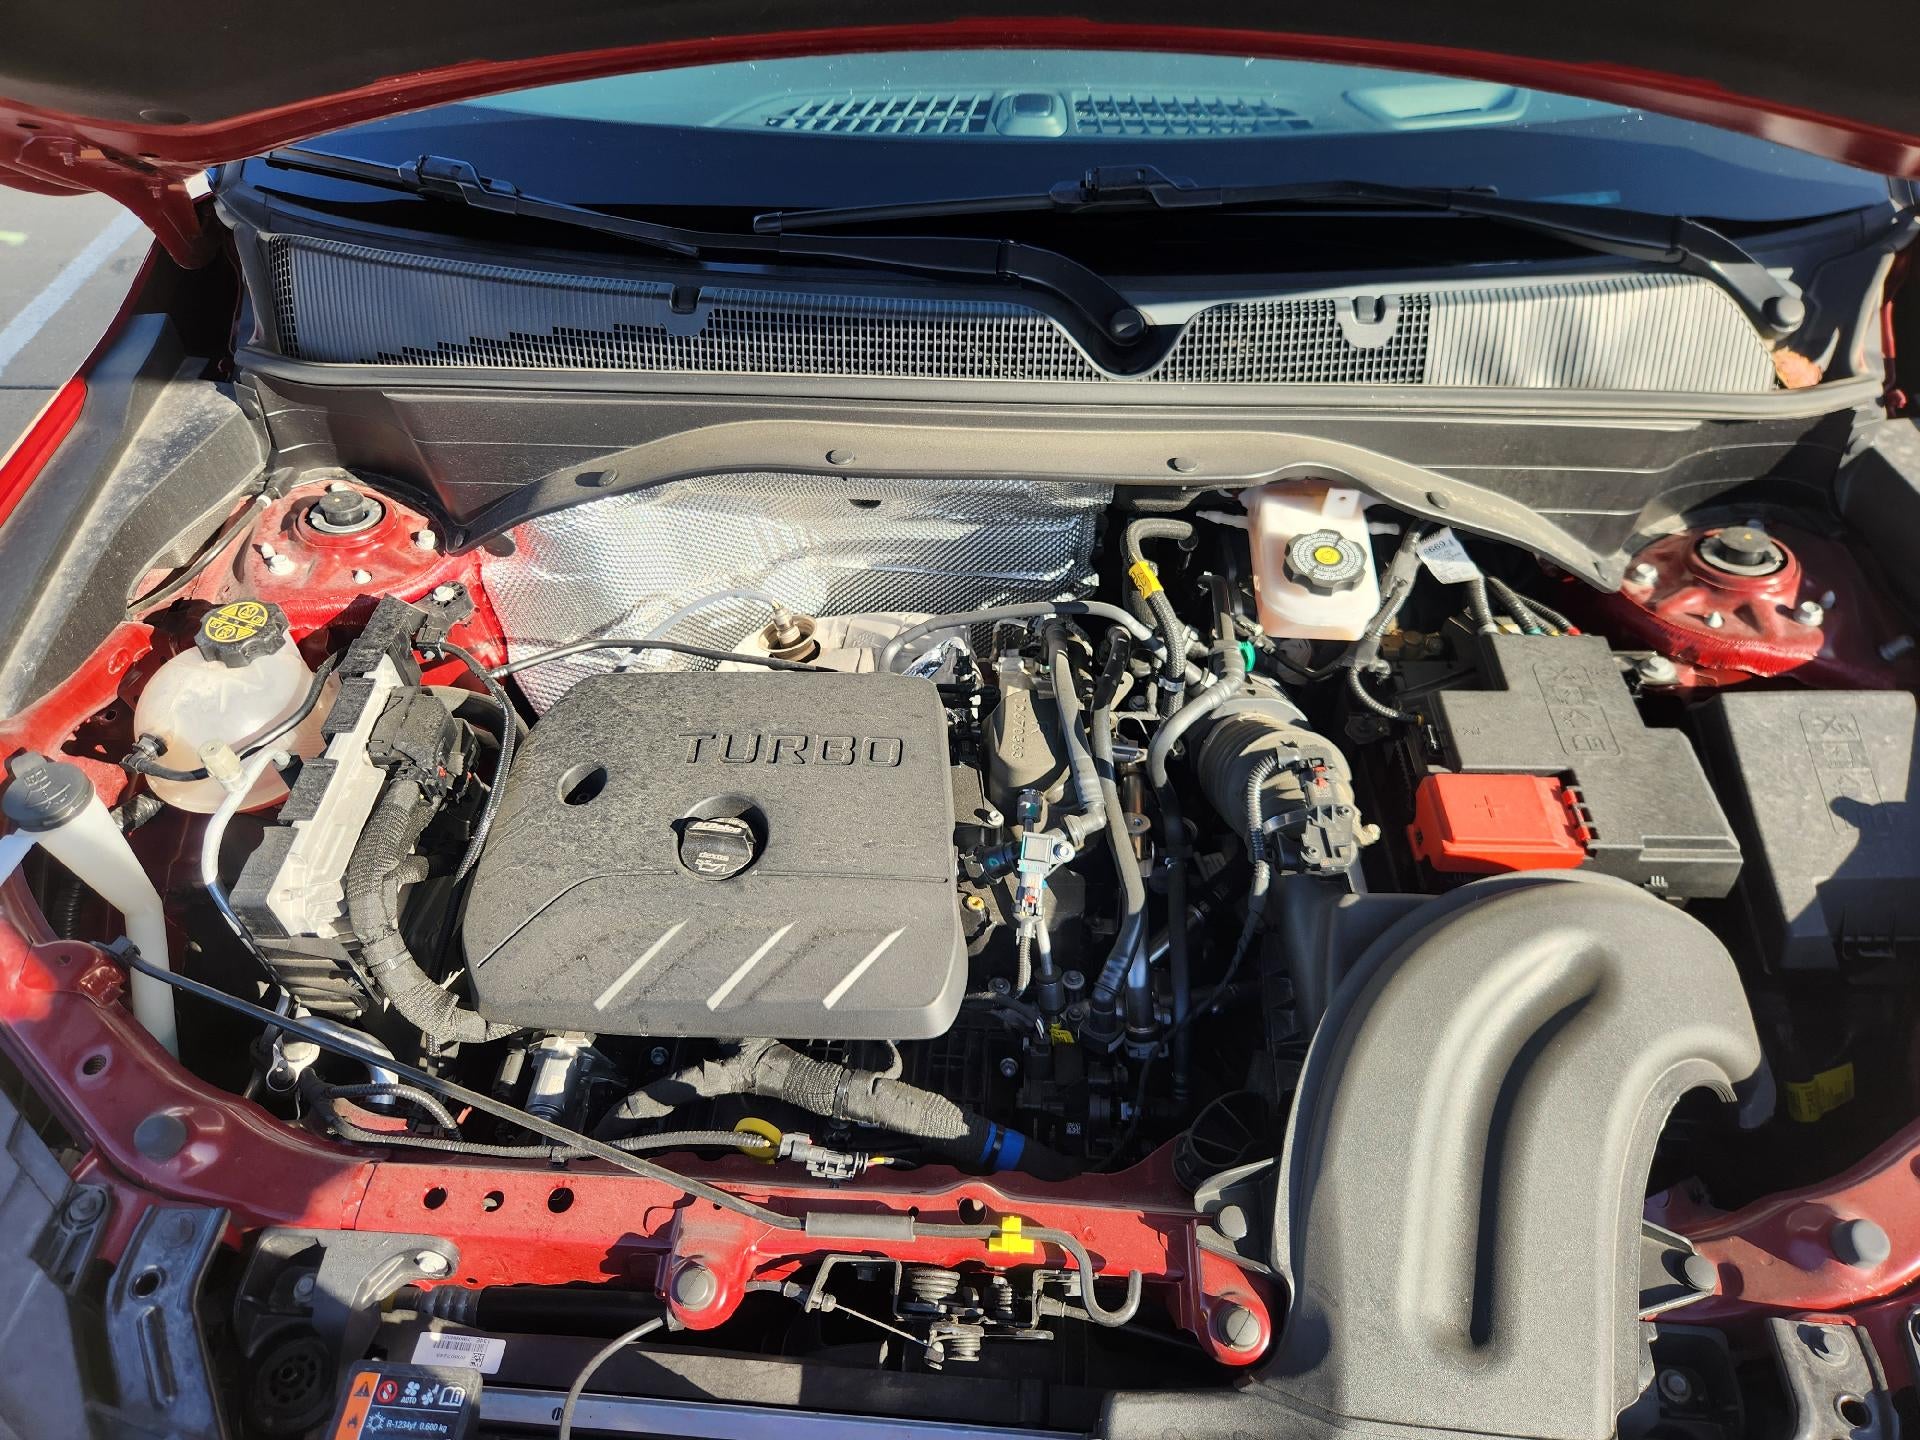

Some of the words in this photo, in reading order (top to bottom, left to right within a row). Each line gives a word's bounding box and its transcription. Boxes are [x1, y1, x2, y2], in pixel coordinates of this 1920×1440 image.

[678, 734, 903, 767] TURBO
[400, 1396, 417, 1405] AUTO
[386, 1420, 417, 1432] R-1234yf
[419, 1421, 438, 1432] 0.600
[438, 1424, 448, 1434] kg
